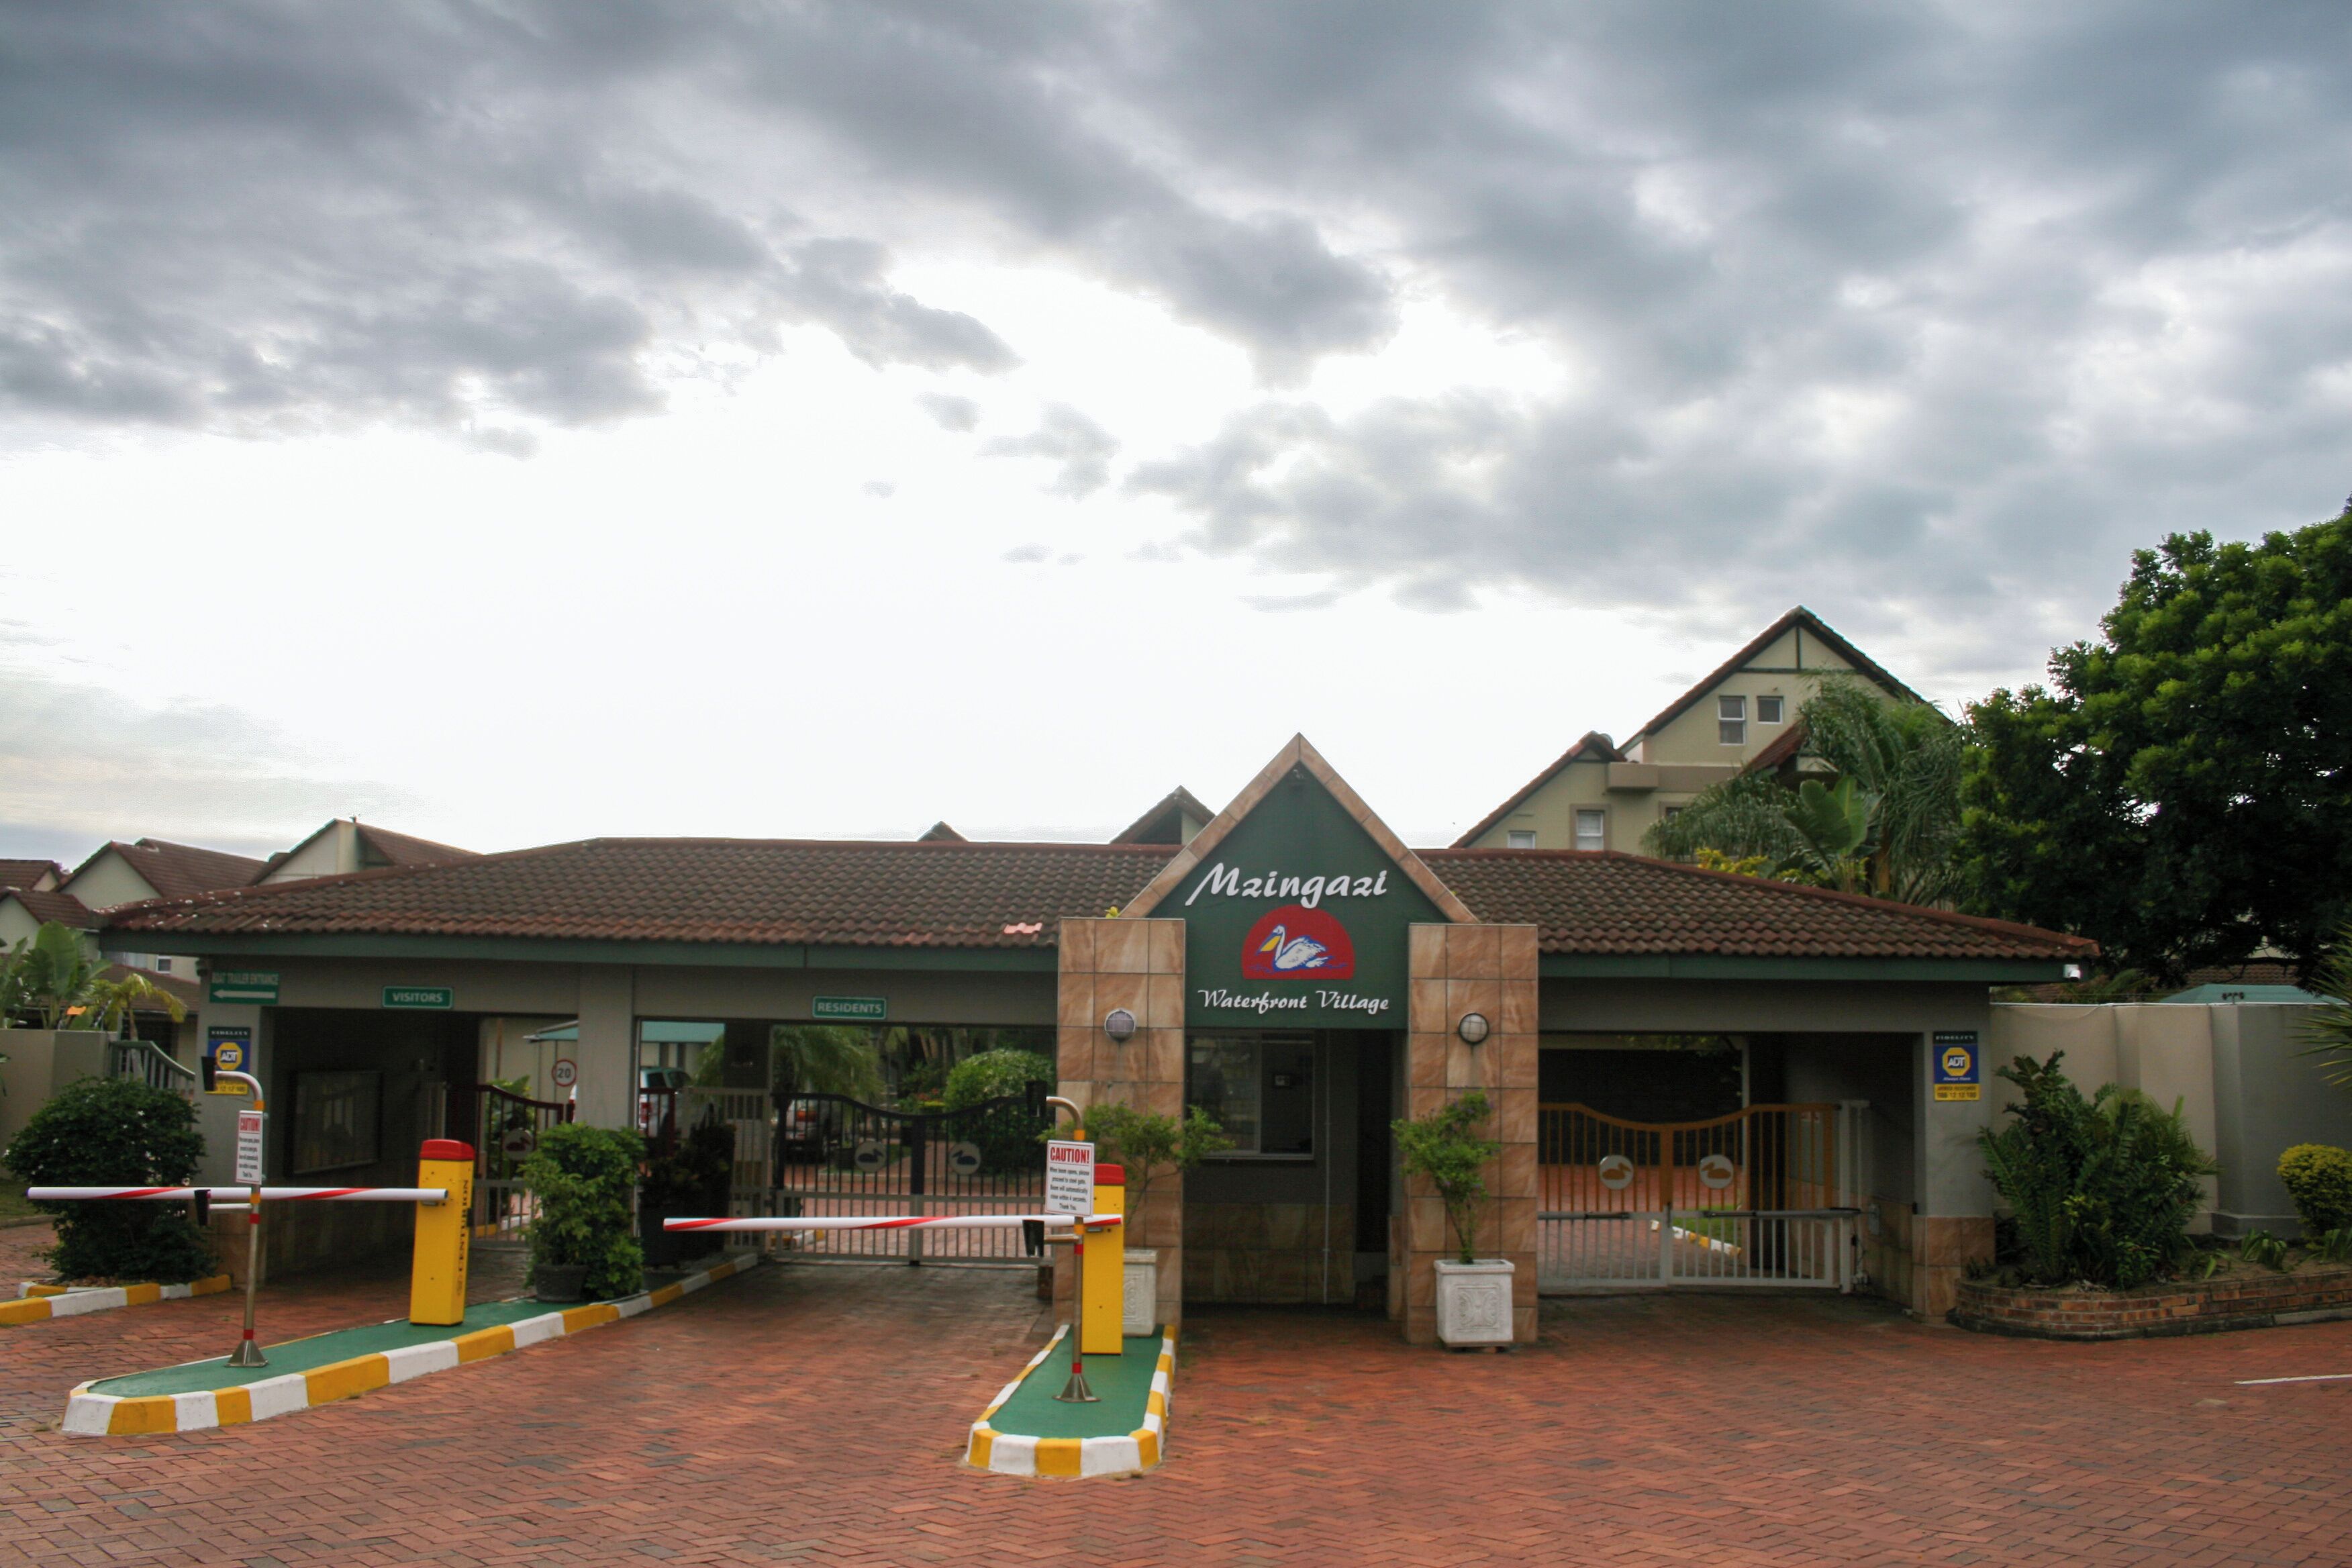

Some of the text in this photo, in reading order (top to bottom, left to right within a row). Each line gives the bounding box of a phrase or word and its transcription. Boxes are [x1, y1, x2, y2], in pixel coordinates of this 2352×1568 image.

[1185, 862, 1387, 909] Mzingazi
[228, 973, 248, 985] TRAILER
[250, 973, 279, 985] ENTRANCE
[392, 993, 442, 1003] VISITORS
[1197, 989, 1389, 1014] Waterfront Village
[817, 1002, 882, 1014] RESIDENTS
[220, 1051, 238, 1061] ADT
[1948, 1056, 1965, 1067] ADT
[557, 1068, 571, 1079] 20
[1050, 1146, 1090, 1164] CAUTION!
